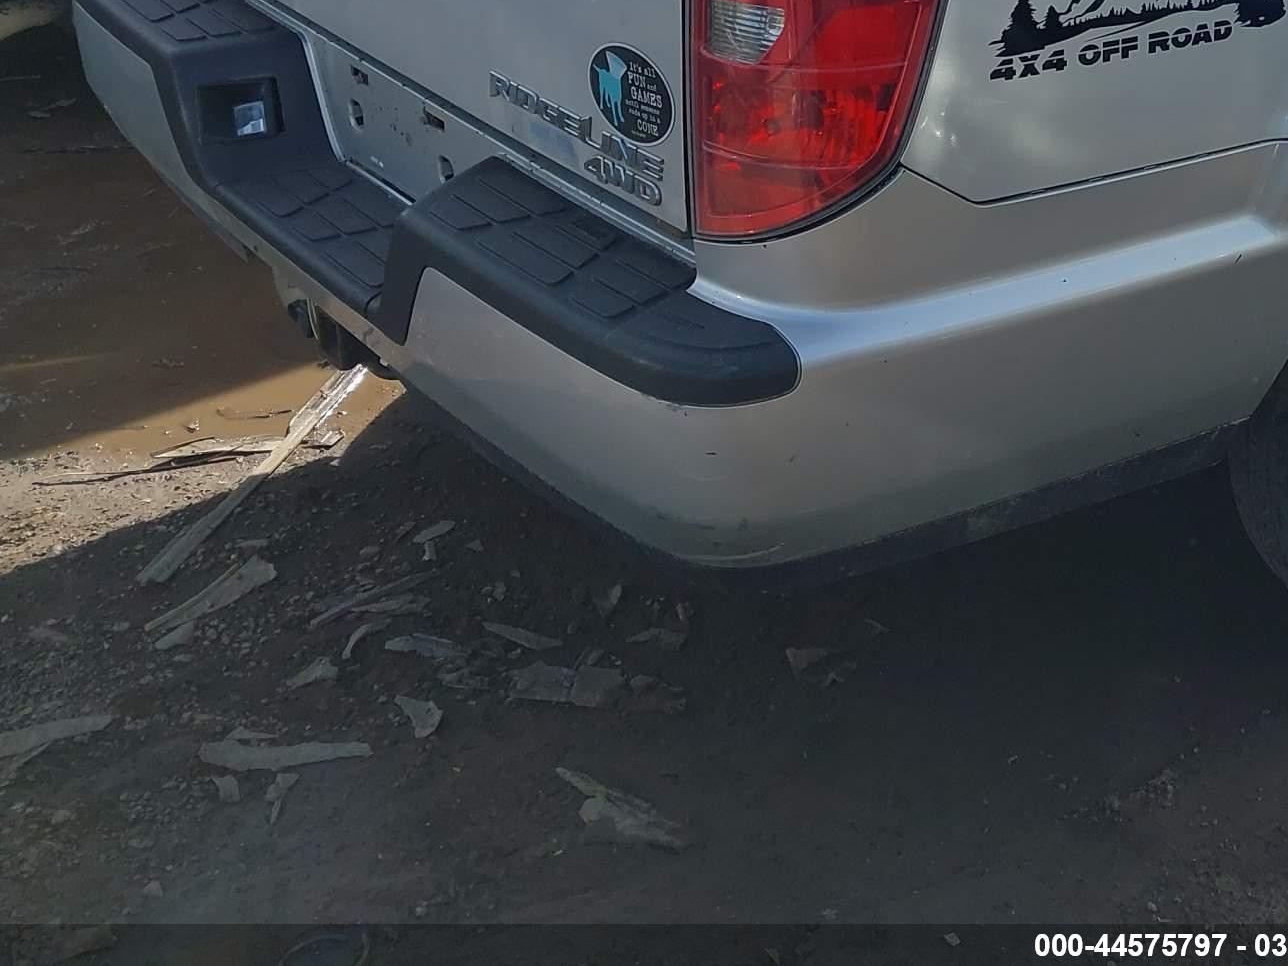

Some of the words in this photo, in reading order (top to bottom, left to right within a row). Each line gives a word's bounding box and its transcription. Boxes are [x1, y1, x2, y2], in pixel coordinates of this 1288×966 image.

[1078, 36, 1139, 66] OFF
[1148, 19, 1234, 54] ROAD
[627, 71, 646, 88] FUN
[644, 67, 656, 78] all
[630, 86, 663, 108] GAMES
[489, 70, 665, 181] RIDGELINE
[637, 119, 659, 137] CONE
[584, 155, 662, 206] 4WD
